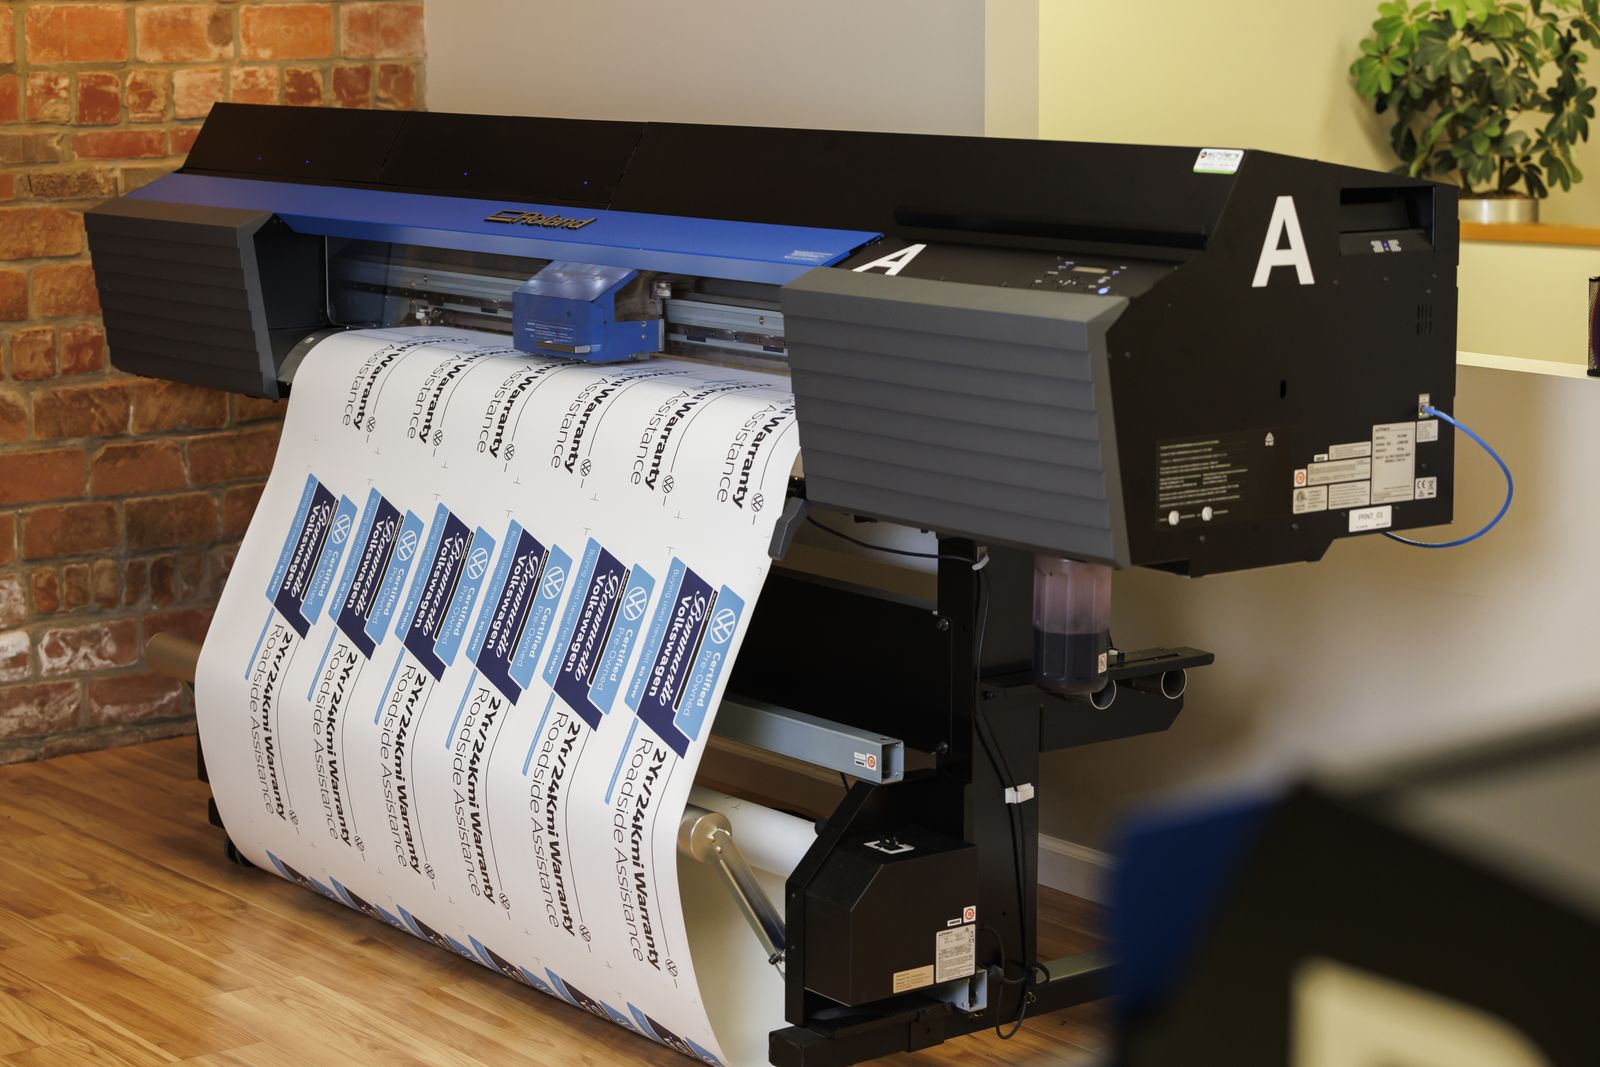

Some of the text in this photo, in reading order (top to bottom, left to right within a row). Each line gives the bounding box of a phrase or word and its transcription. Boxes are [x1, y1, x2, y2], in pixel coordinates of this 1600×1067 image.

[507, 210, 598, 230] Roland
[852, 243, 927, 276] A
[1251, 195, 1315, 288] A
[343, 344, 395, 425] Assistance
[354, 350, 399, 430] Warranty
[407, 354, 461, 438] Assistance
[419, 362, 467, 443] Warranty
[477, 366, 533, 452] Assistance
[490, 374, 539, 458] Warranty
[551, 378, 608, 468] Assistance
[564, 386, 615, 474] Warranty
[631, 391, 691, 485] Assistance
[645, 402, 697, 491] Warranty
[717, 405, 777, 502] Assistance
[733, 414, 786, 509] Warranty
[284, 505, 321, 590] Volkswagen
[290, 501, 330, 598] Bommarito
[307, 549, 332, 606] Pre-Owned
[318, 551, 338, 598] Certified
[347, 521, 384, 608] Volkswagen
[354, 516, 395, 616] Bommarito
[415, 537, 453, 628] Volkswagen
[423, 533, 464, 636] Bommarito
[332, 592, 341, 610] new
[373, 567, 398, 624] Pre-Owned
[383, 569, 404, 616] Certified
[399, 611, 408, 630] new
[406, 600, 412, 610] so
[442, 586, 468, 645] Pre-Owned
[453, 588, 475, 636] Certified
[478, 620, 484, 631] so
[487, 555, 527, 649] Volkswagen
[496, 550, 538, 658] Bommarito
[529, 608, 551, 658] Certified
[565, 575, 606, 672] Volkswagen
[574, 570, 618, 681] Bommarito
[470, 632, 480, 651] new
[517, 606, 544, 667] Pre-Owned
[547, 654, 557, 674] new
[555, 641, 562, 652] so
[597, 627, 625, 691] Pre-Owned
[610, 630, 633, 682] Certified
[638, 665, 645, 676] so
[648, 596, 692, 697] Volkswagen
[660, 591, 705, 706] Bommarito
[250, 624, 284, 814] Roadside Assistance
[630, 677, 641, 698] new
[682, 650, 712, 717] Pre-Owned
[697, 653, 721, 707] Certified
[265, 735, 286, 820] Warranty
[313, 644, 348, 840] Roadside Assistance
[381, 665, 416, 867] Roadside Assistance
[329, 759, 351, 847] Warranty
[397, 785, 421, 875] Warranty
[453, 687, 490, 897] Roadside Assistance
[530, 711, 568, 928] Roadside Assistance
[470, 812, 496, 904] Warranty
[549, 841, 575, 936] Warranty
[613, 738, 653, 962] Roadside Assistance
[634, 872, 660, 971] Warranty
